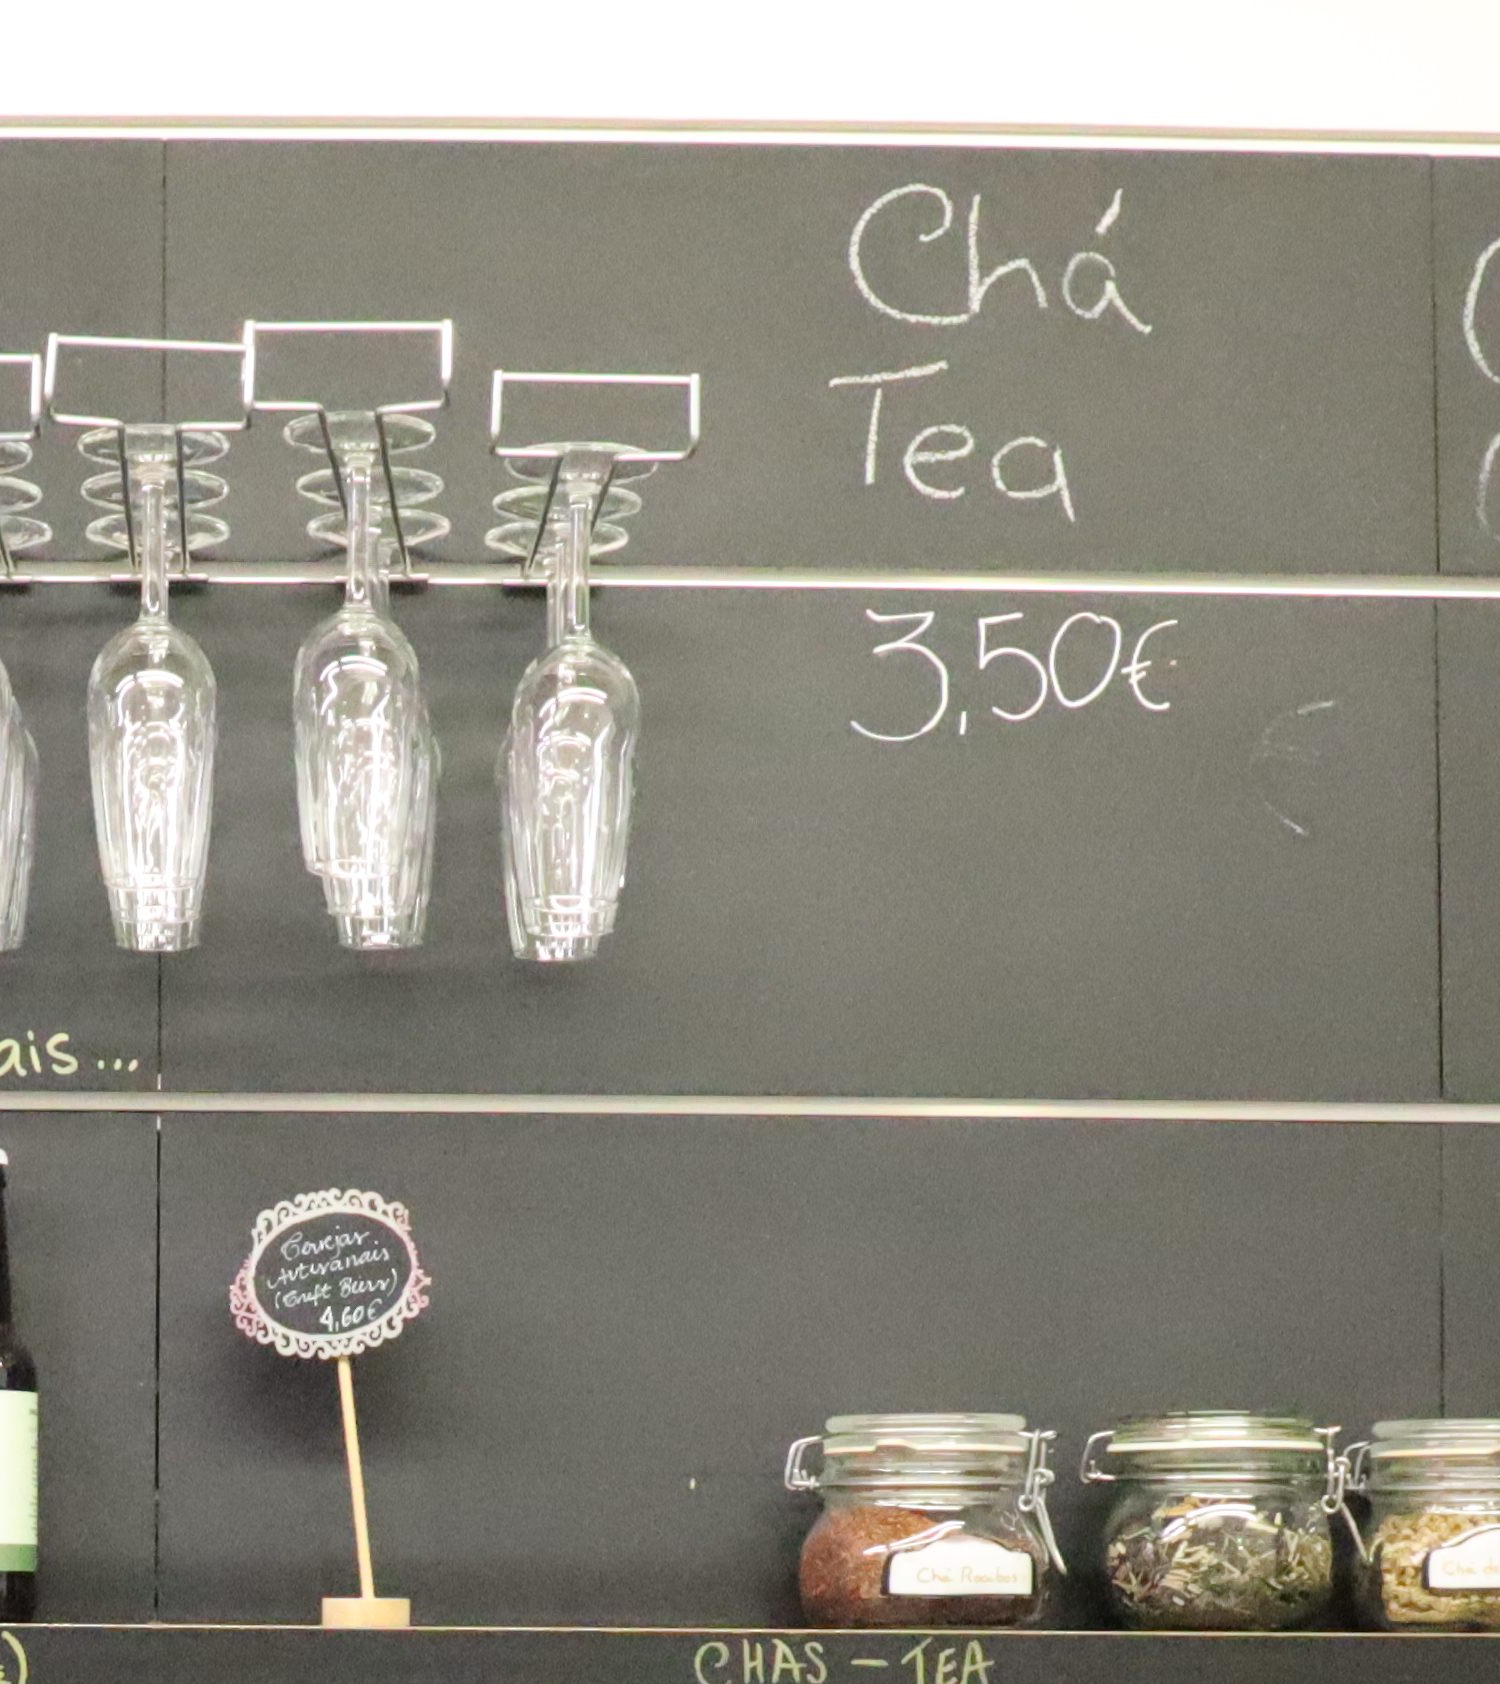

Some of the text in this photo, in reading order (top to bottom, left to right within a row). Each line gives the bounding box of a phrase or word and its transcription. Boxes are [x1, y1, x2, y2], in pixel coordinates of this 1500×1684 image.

[850, 183, 1153, 335] Chá
[828, 360, 1076, 523] Tea
[850, 610, 1180, 742] 3,50€
[319, 1298, 383, 1332] 4,60€
